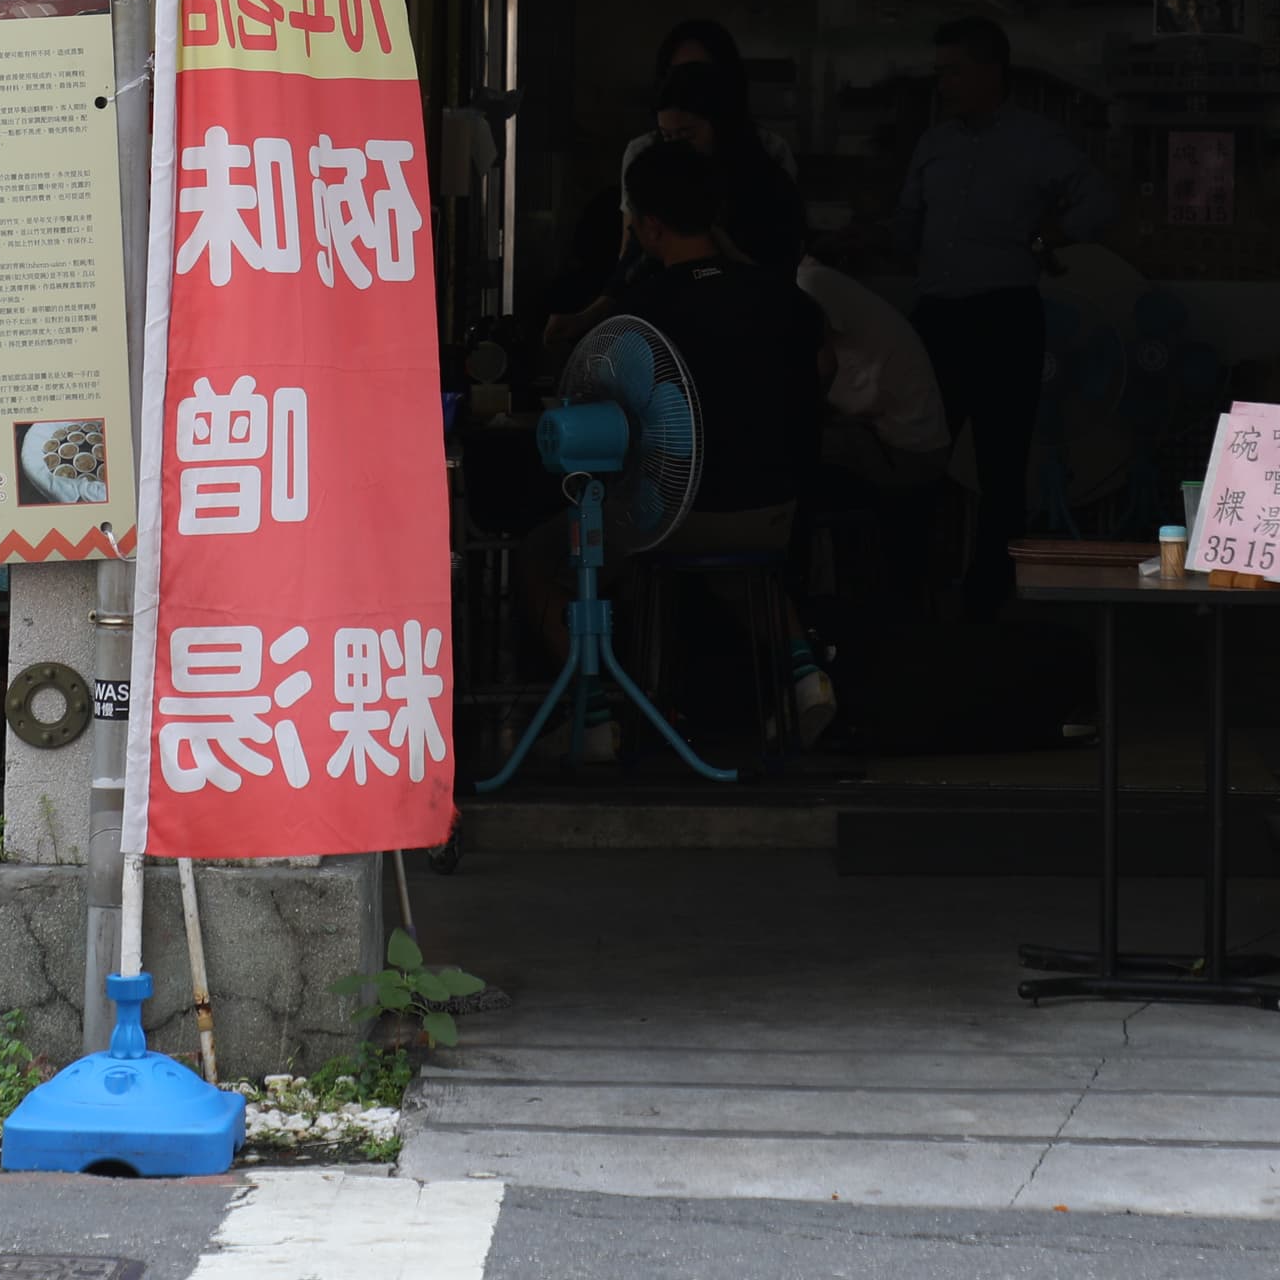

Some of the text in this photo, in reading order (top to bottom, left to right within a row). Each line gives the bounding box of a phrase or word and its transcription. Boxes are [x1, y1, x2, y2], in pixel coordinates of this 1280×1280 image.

[1204, 426, 1262, 565] 碗粿 35
[1243, 541, 1276, 571] 15
